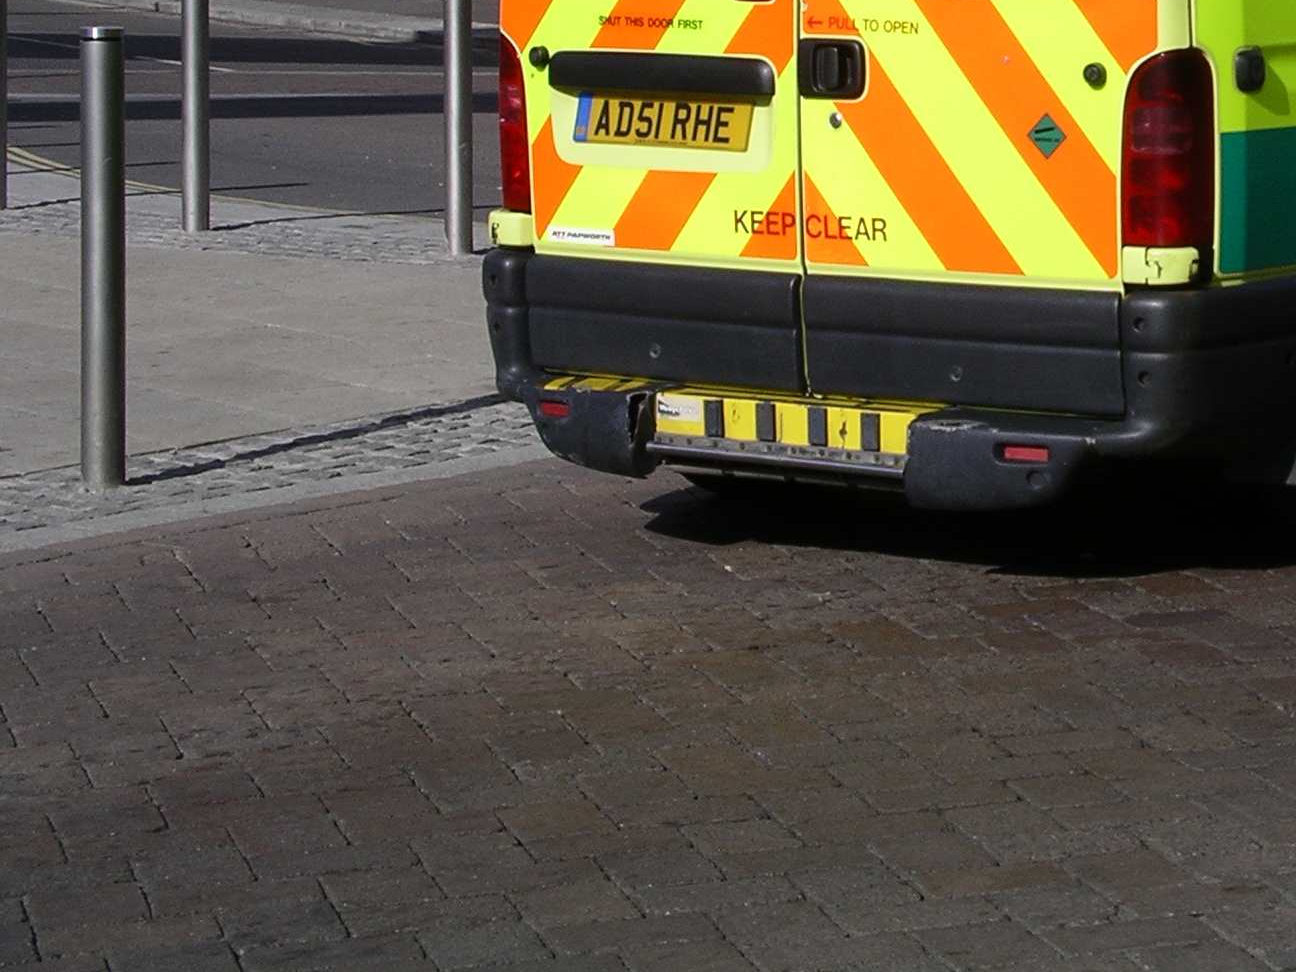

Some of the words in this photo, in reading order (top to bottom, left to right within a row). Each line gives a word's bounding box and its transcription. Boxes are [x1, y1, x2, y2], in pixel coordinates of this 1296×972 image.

[598, 15, 622, 27] SHUT
[624, 16, 645, 28] THIS
[647, 17, 674, 29] DOOR
[677, 18, 704, 31] FIRST
[828, 16, 859, 32] PULL
[862, 17, 880, 33] TO
[883, 19, 920, 35] OPEN
[594, 99, 665, 140] AD51
[670, 102, 735, 144] RHE
[733, 209, 797, 237] KEEP
[805, 213, 888, 242] CLEAR
[566, 231, 611, 240] PAPWORTH
